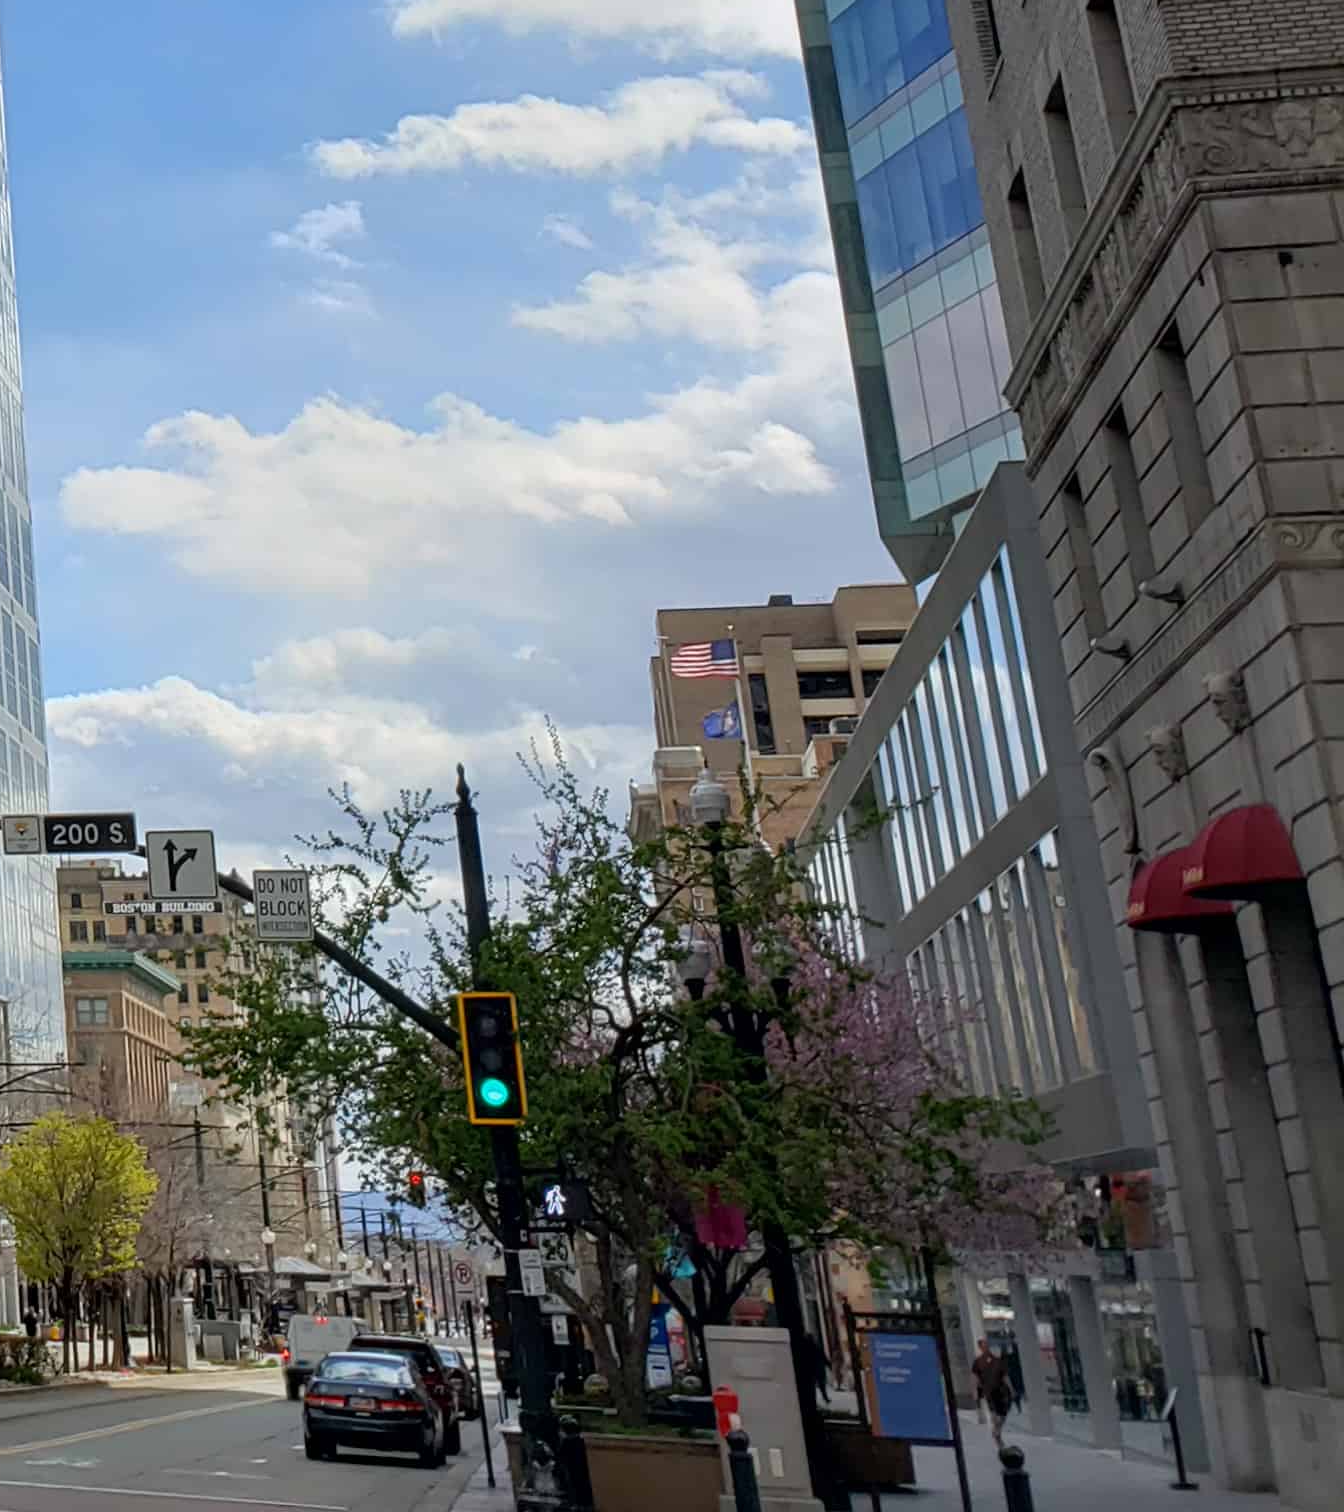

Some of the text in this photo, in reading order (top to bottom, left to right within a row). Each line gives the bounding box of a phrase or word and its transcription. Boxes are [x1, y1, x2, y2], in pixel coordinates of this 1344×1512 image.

[52, 823, 99, 846] 200
[109, 821, 128, 844] S.
[257, 877, 305, 894] DO NOT
[112, 901, 215, 914] BOSTON BUILDING
[259, 900, 307, 917] BLOCK
